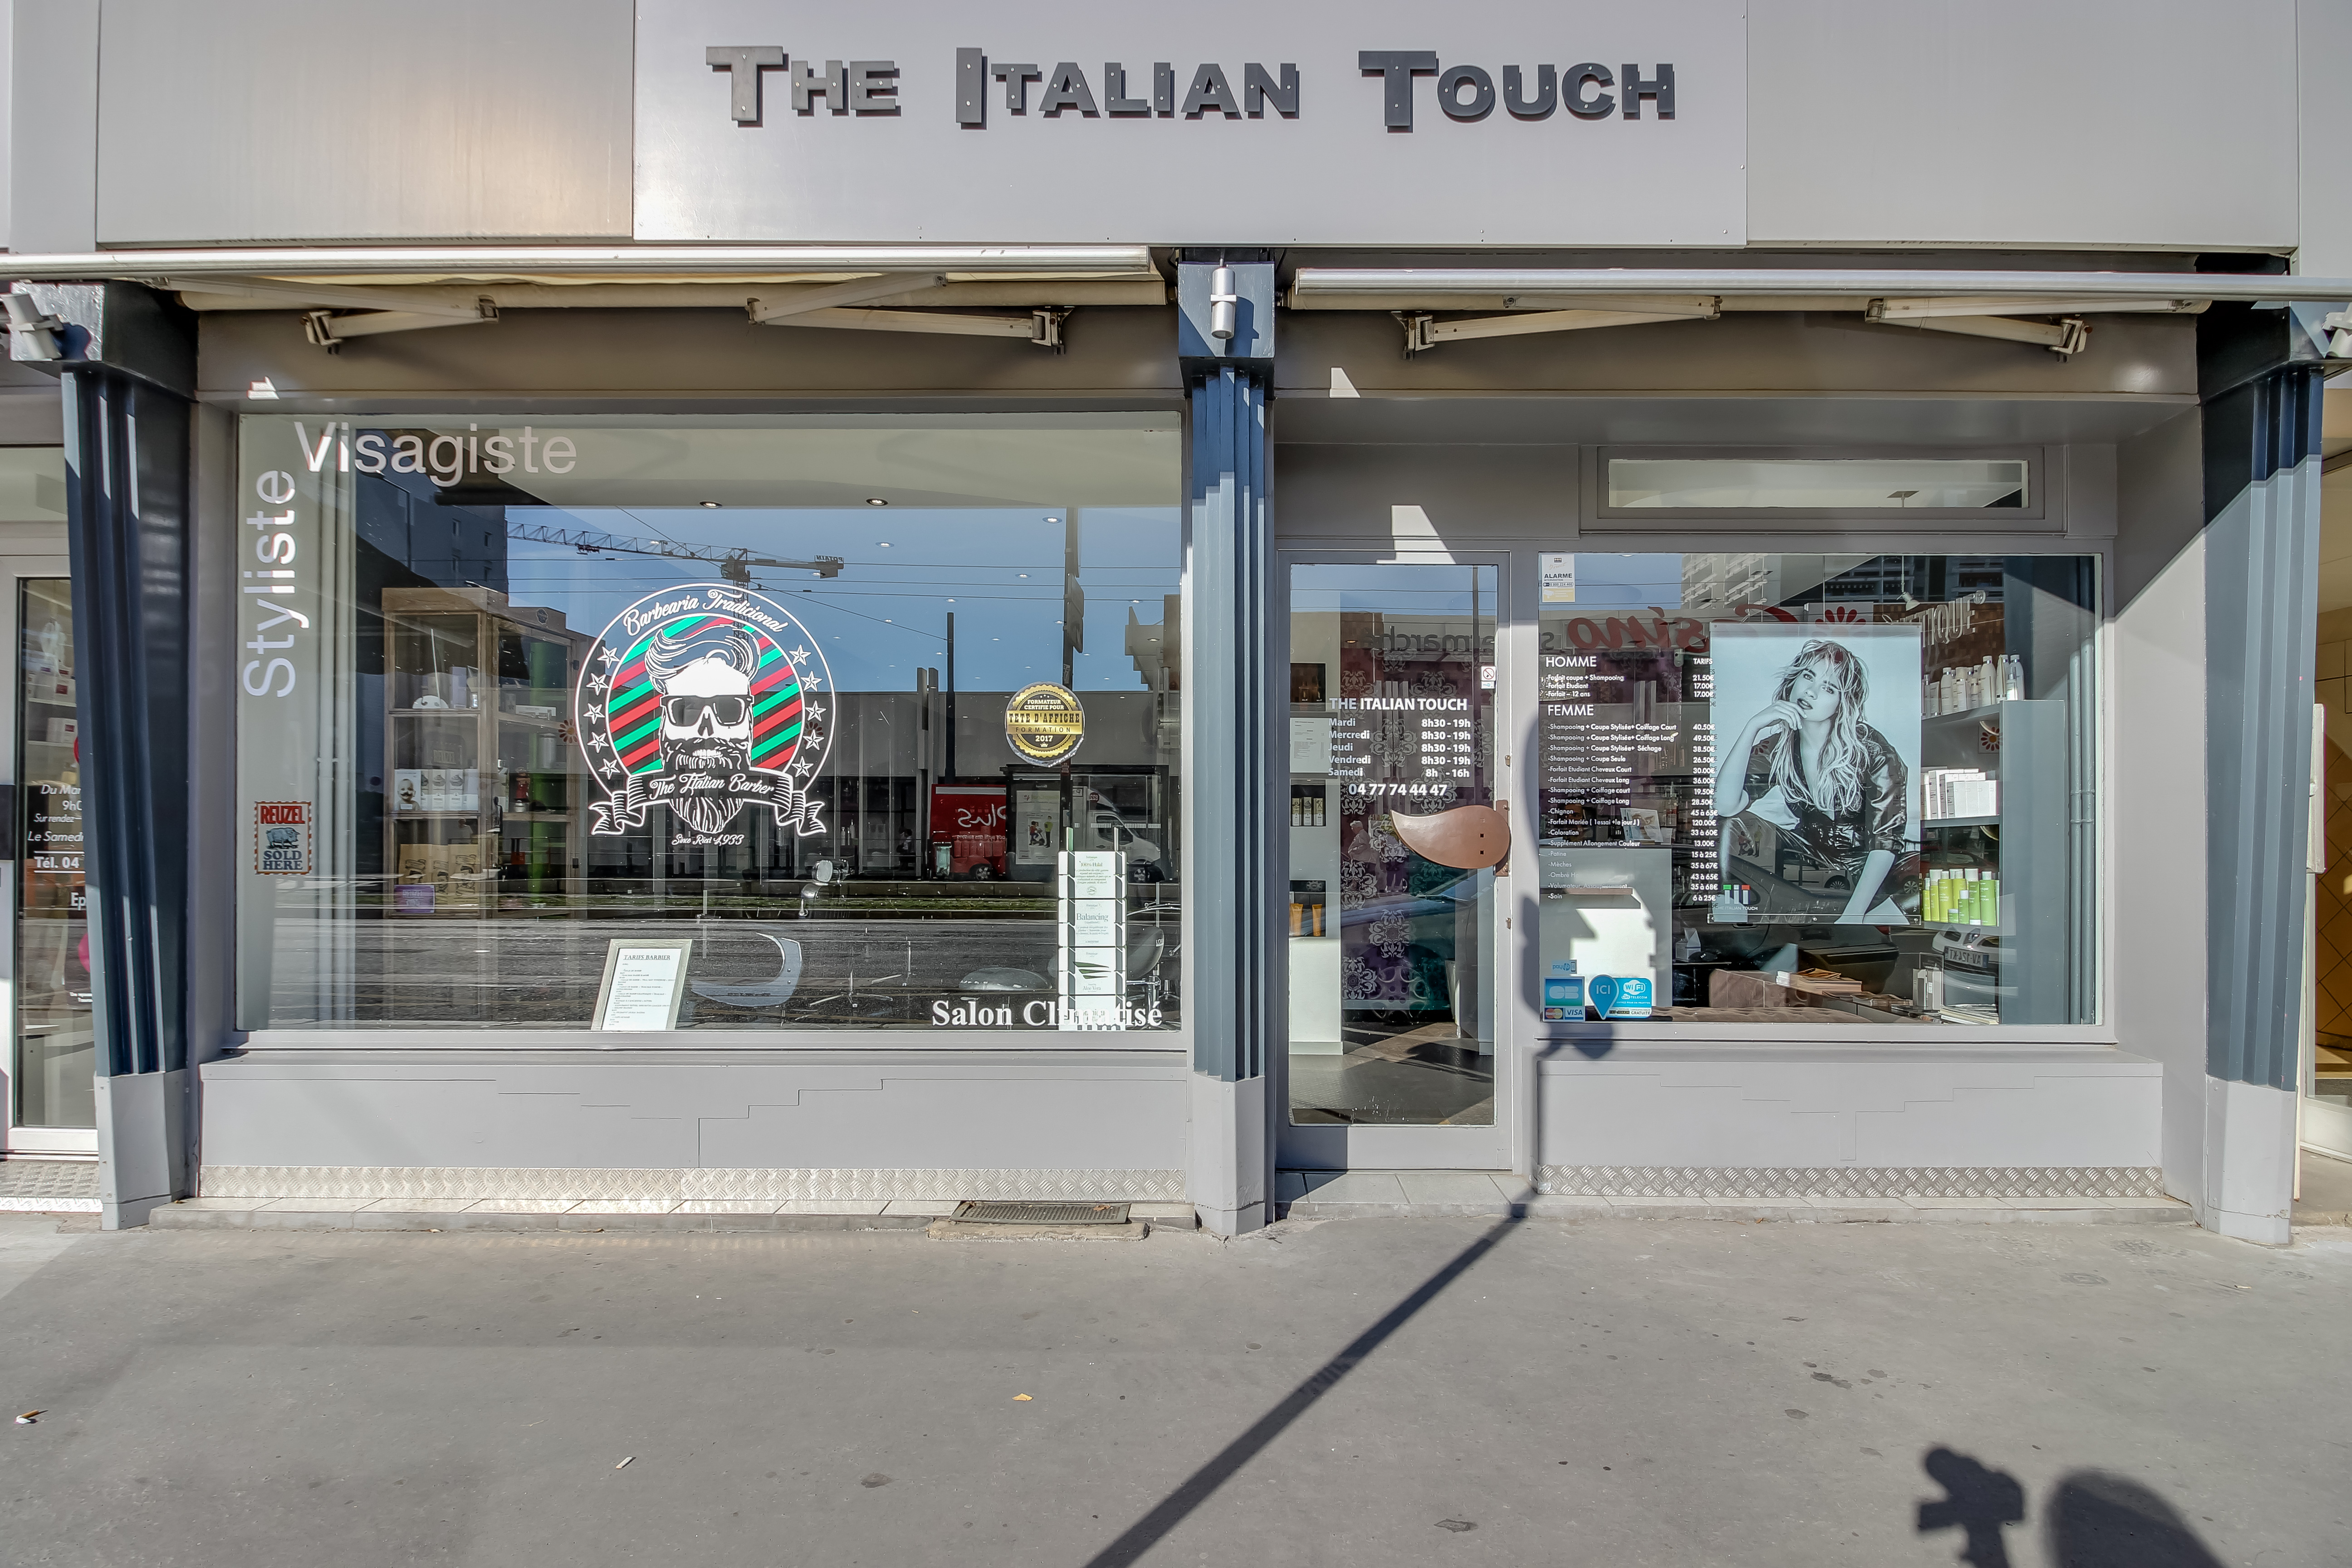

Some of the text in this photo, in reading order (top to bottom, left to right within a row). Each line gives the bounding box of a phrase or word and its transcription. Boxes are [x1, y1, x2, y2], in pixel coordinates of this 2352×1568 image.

[294, 421, 576, 487] Visagiste
[243, 470, 310, 697] Styliste
[623, 589, 789, 636] Barbearia Tradicional
[1546, 656, 1597, 667] HOMME
[1329, 698, 1468, 711] THE ITALIAN TOUCH
[1548, 704, 1594, 716] FEMME
[1009, 713, 1080, 723] TETE D'AFFICHE
[1328, 718, 1471, 728] Mardi 8h30 19h
[1328, 730, 1471, 740] Mercredi 8h30 19h
[1328, 743, 1471, 752] Jeudi 8h30 19h
[1328, 755, 1471, 765] Vendredi 8h30 19h
[1328, 768, 1470, 777] Samedi 8h 16h
[41, 784, 57, 794] Du
[649, 771, 775, 799] The Italian Barber
[1348, 784, 1448, 795] 04 77 74 44 47
[260, 805, 305, 824] REUZEL
[28, 831, 42, 841] Le
[263, 850, 302, 860] SOLD
[34, 856, 79, 868] Tél. 04
[263, 860, 303, 870] HERE
[1076, 913, 1109, 922] Balancing
[1596, 985, 1610, 995] ICI
[931, 1000, 1014, 1028] Salon
